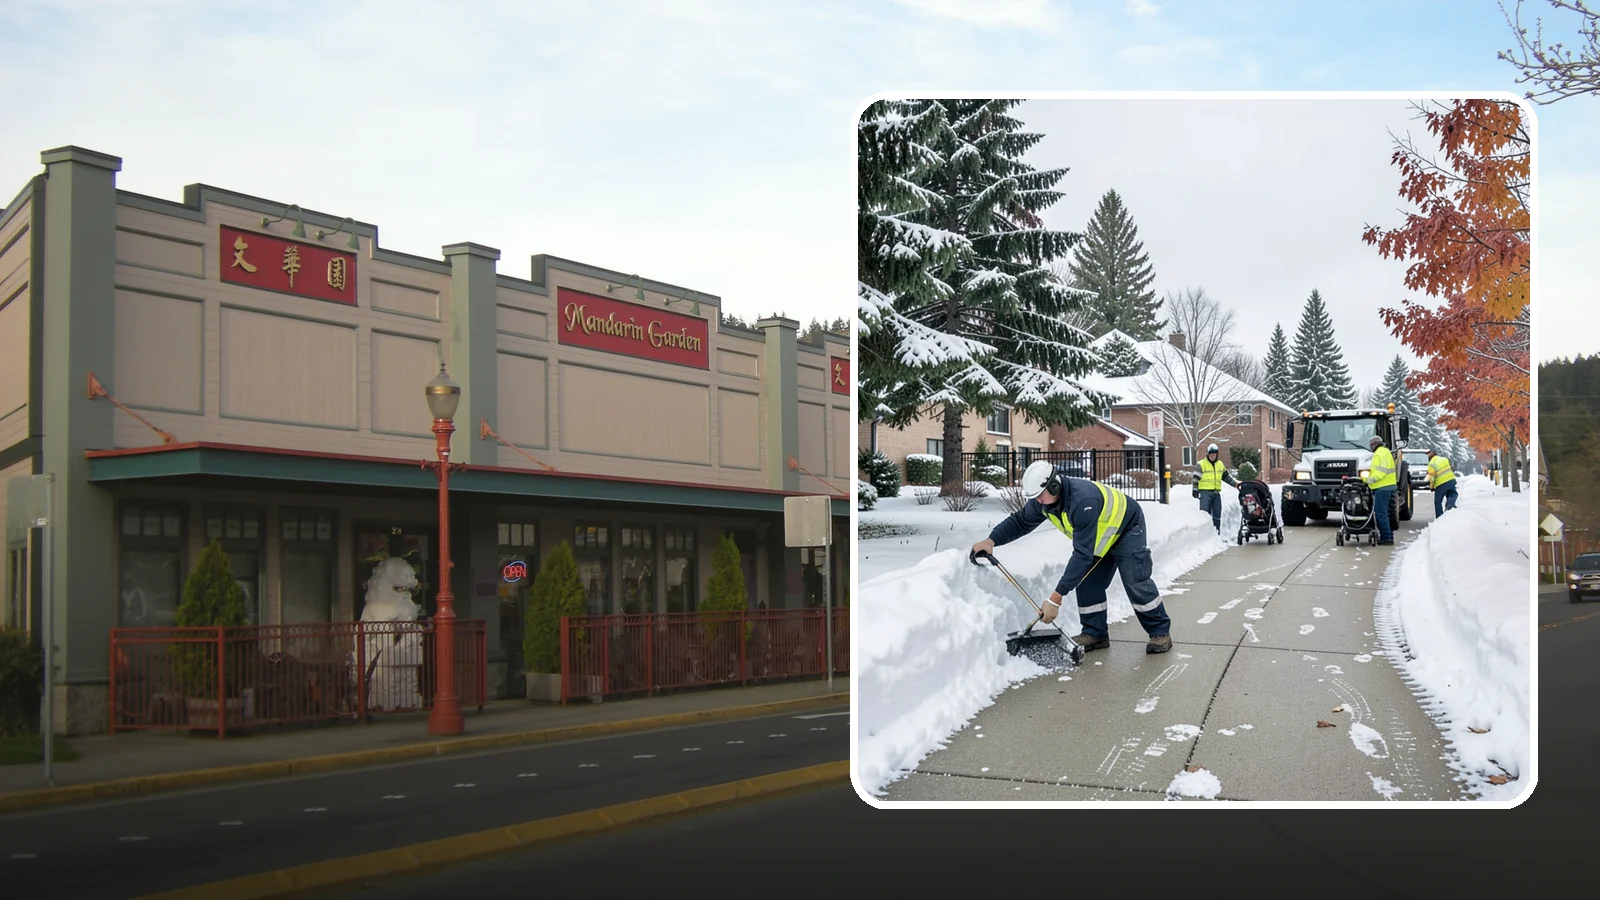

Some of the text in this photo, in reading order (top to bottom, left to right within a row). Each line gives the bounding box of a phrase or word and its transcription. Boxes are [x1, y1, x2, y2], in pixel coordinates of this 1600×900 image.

[231, 236, 346, 291] 文華園
[564, 302, 702, 352] Mandarin Garden
[503, 565, 527, 578] OPEN
